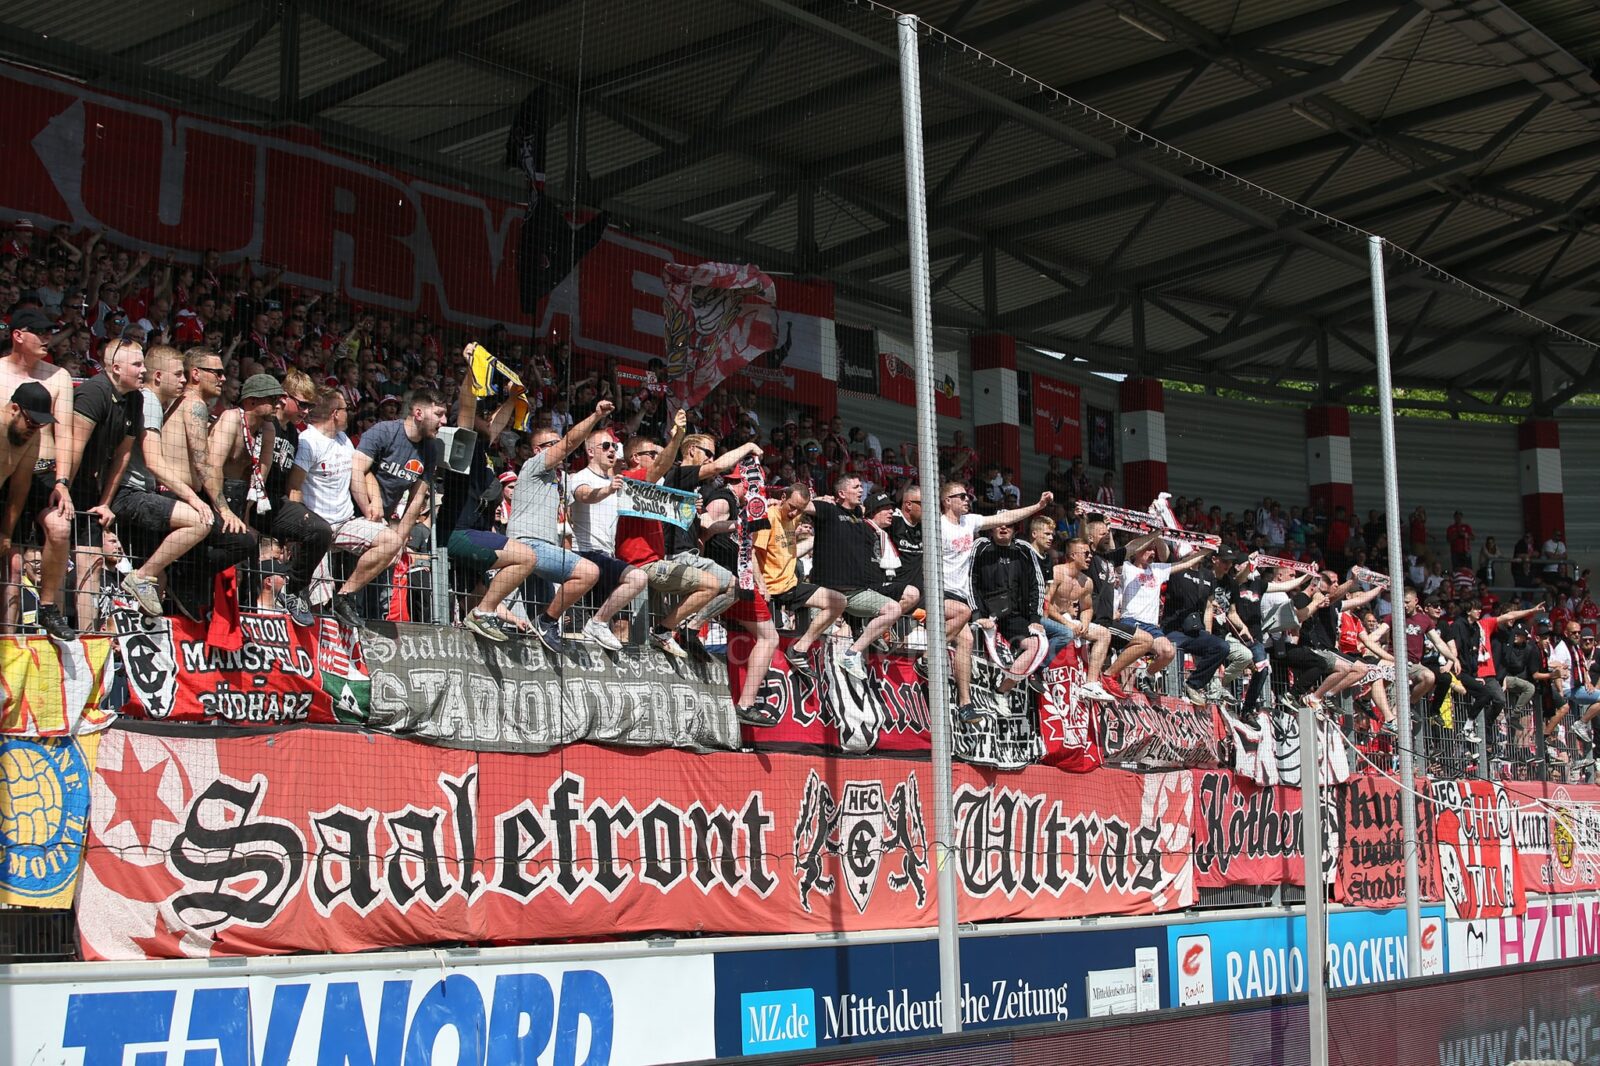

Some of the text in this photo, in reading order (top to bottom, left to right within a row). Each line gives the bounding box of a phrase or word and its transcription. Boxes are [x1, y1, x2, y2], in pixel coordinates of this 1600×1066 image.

[380, 463, 419, 485] elless
[181, 640, 315, 680] MANSFELD
[848, 788, 880, 811] HFC
[168, 766, 780, 932] Saalefront
[952, 783, 1164, 902] Ultras
[1226, 935, 1408, 1001] RADIO ROCKEN
[748, 1003, 810, 1044] MZ.de
[823, 978, 1068, 1040] Mitteldeuthe Zeitung
